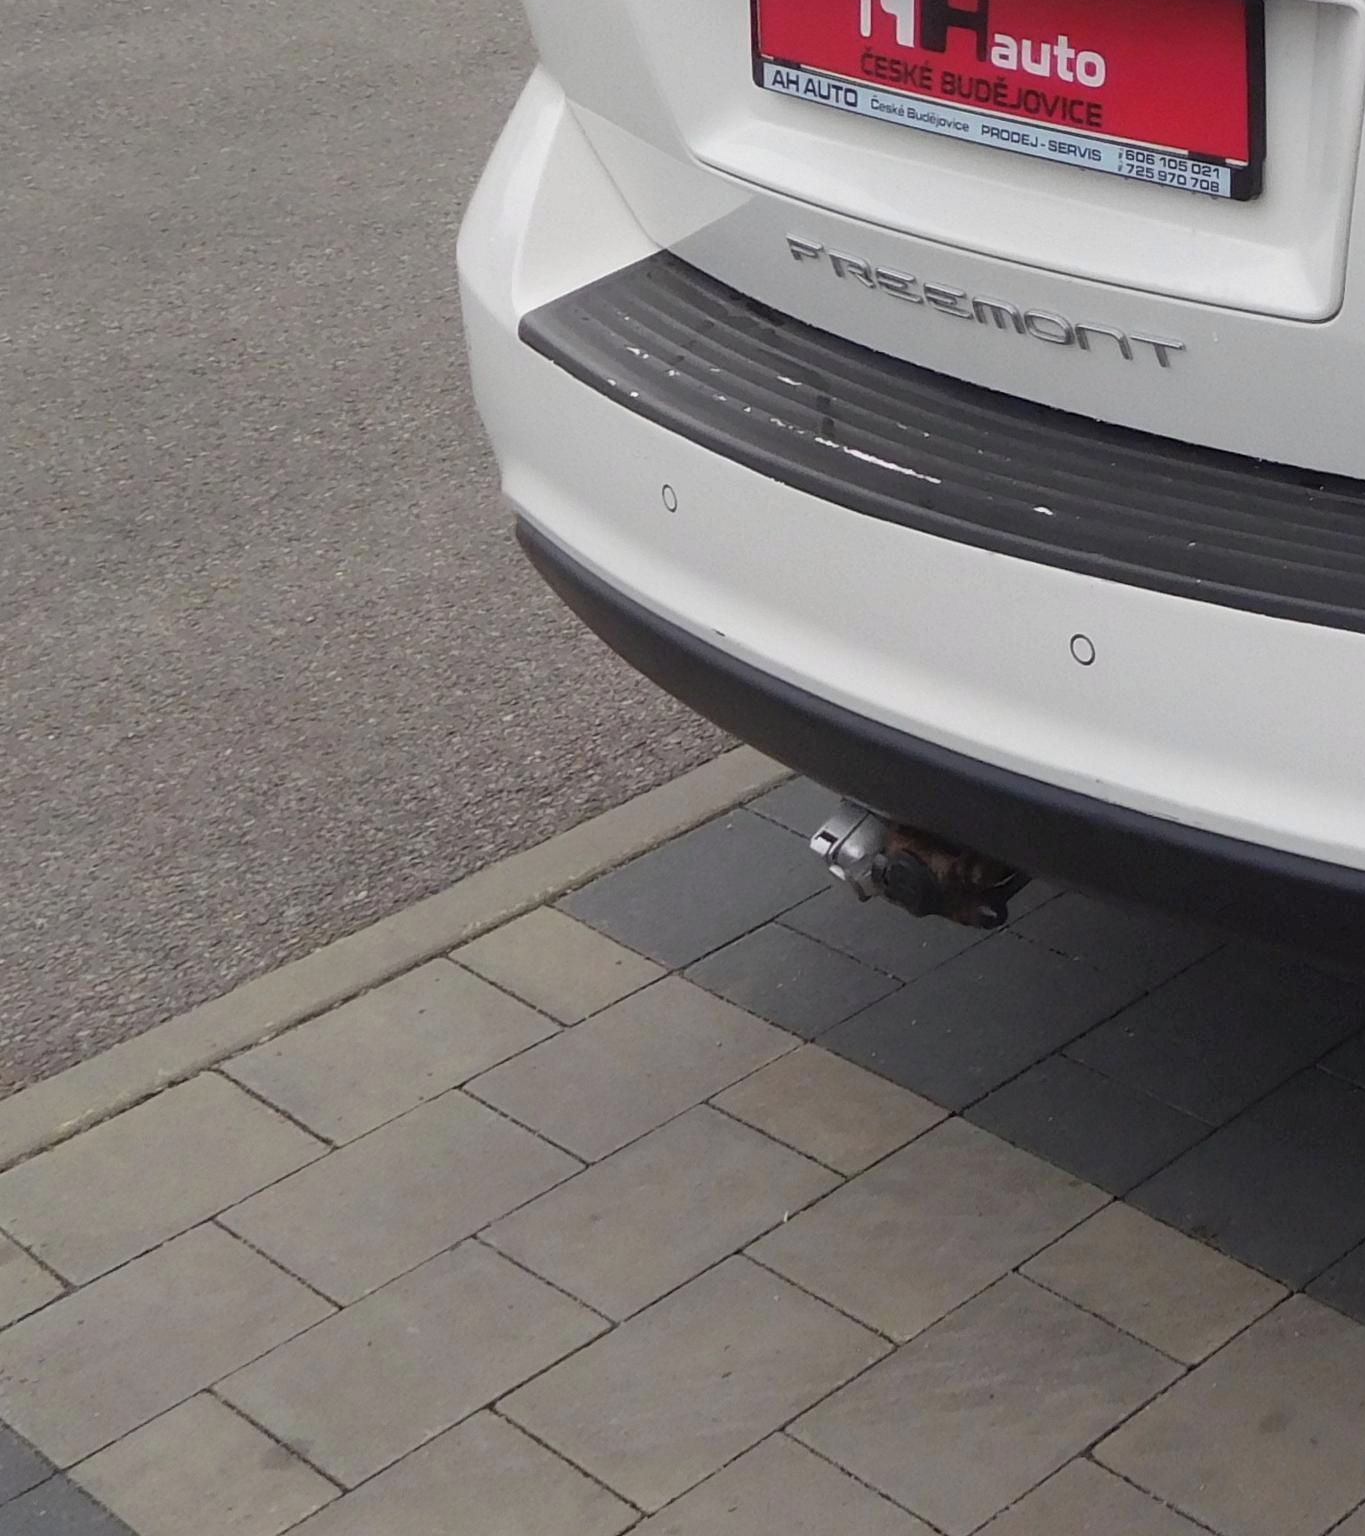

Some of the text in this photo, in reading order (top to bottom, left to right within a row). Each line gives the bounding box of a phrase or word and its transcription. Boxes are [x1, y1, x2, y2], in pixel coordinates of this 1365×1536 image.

[772, 69, 800, 92] AH
[803, 77, 858, 107] AUTO
[870, 94, 905, 117] České
[907, 107, 970, 132] Budějovice
[861, 46, 1103, 127] ČESKÉ BUDĚJOVICE
[1125, 150, 1155, 165] 606
[1160, 157, 1188, 172] 105
[1191, 164, 1220, 179] 021
[1125, 163, 1219, 192] 725 970 708
[785, 231, 1187, 367] FREEMONT
